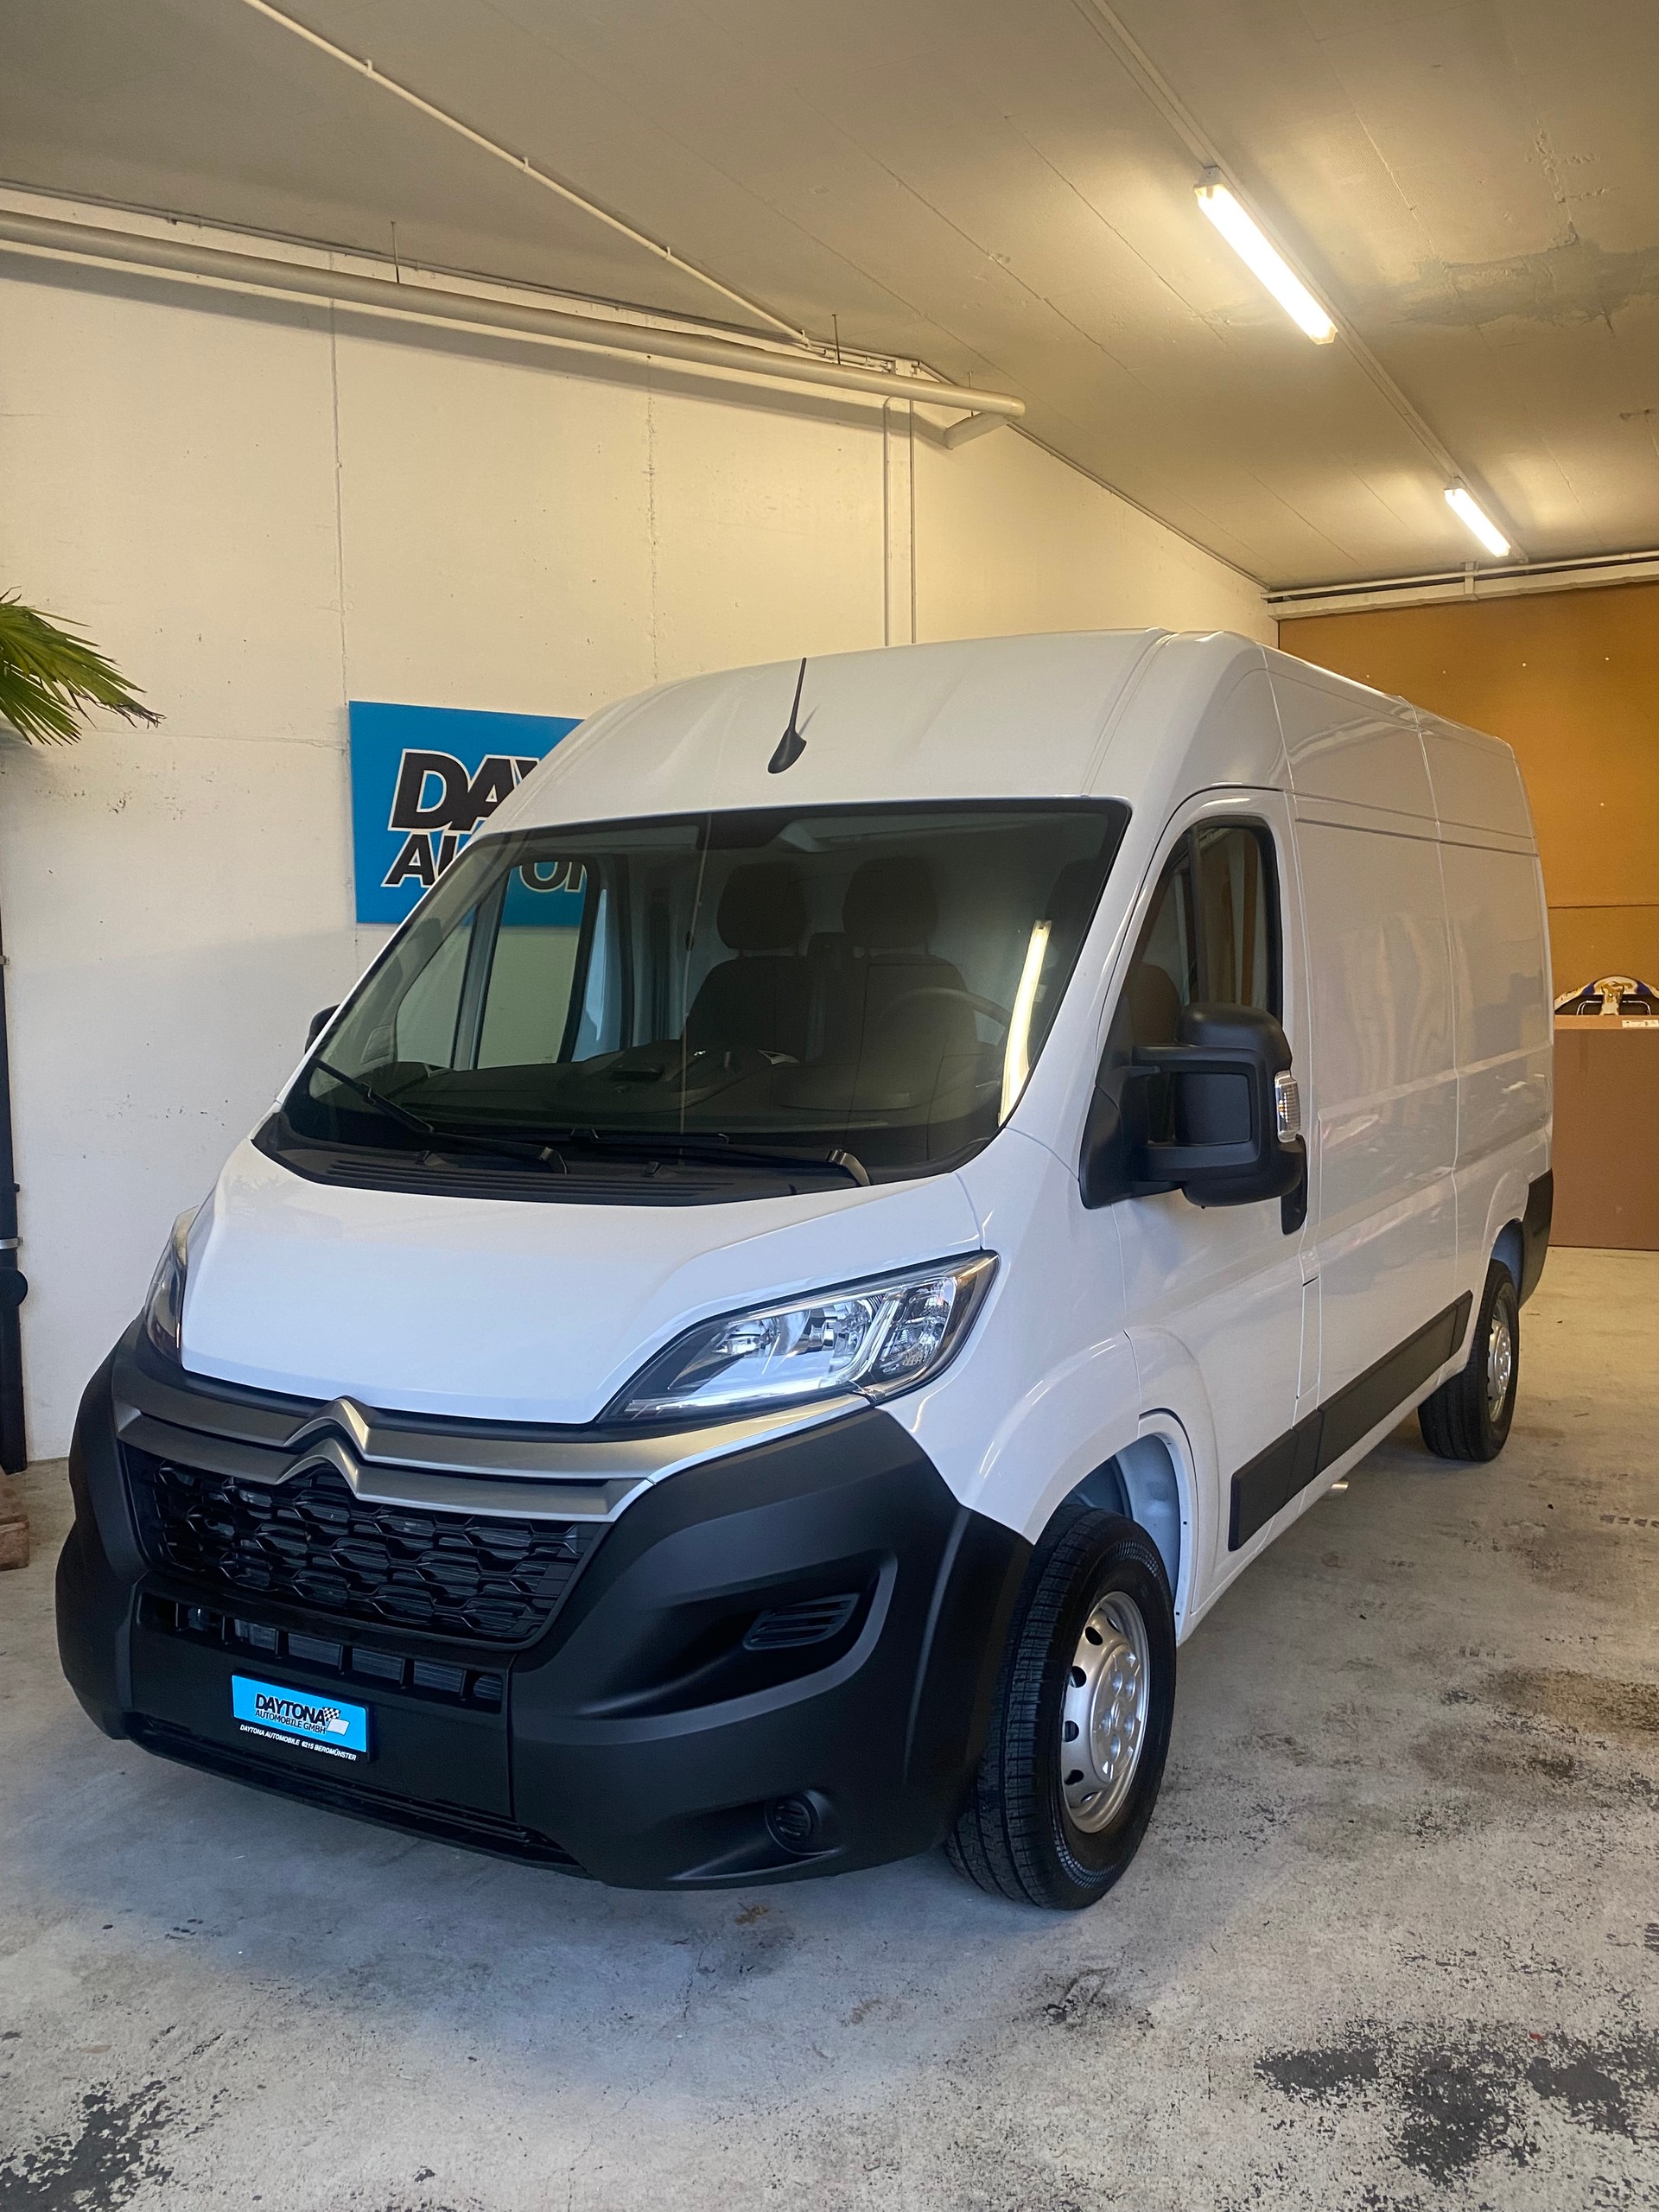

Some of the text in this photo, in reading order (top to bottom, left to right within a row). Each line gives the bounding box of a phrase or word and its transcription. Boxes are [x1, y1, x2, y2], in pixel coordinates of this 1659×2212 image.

[255, 1693, 326, 1725] DAYTONA
[255, 1710, 327, 1735] AUTOMOBILE GMBH
[239, 1725, 264, 1736] DAYTONA
[264, 1732, 300, 1745] AUTOMOBILE
[314, 1745, 357, 1761] BEROMÜNSTER
